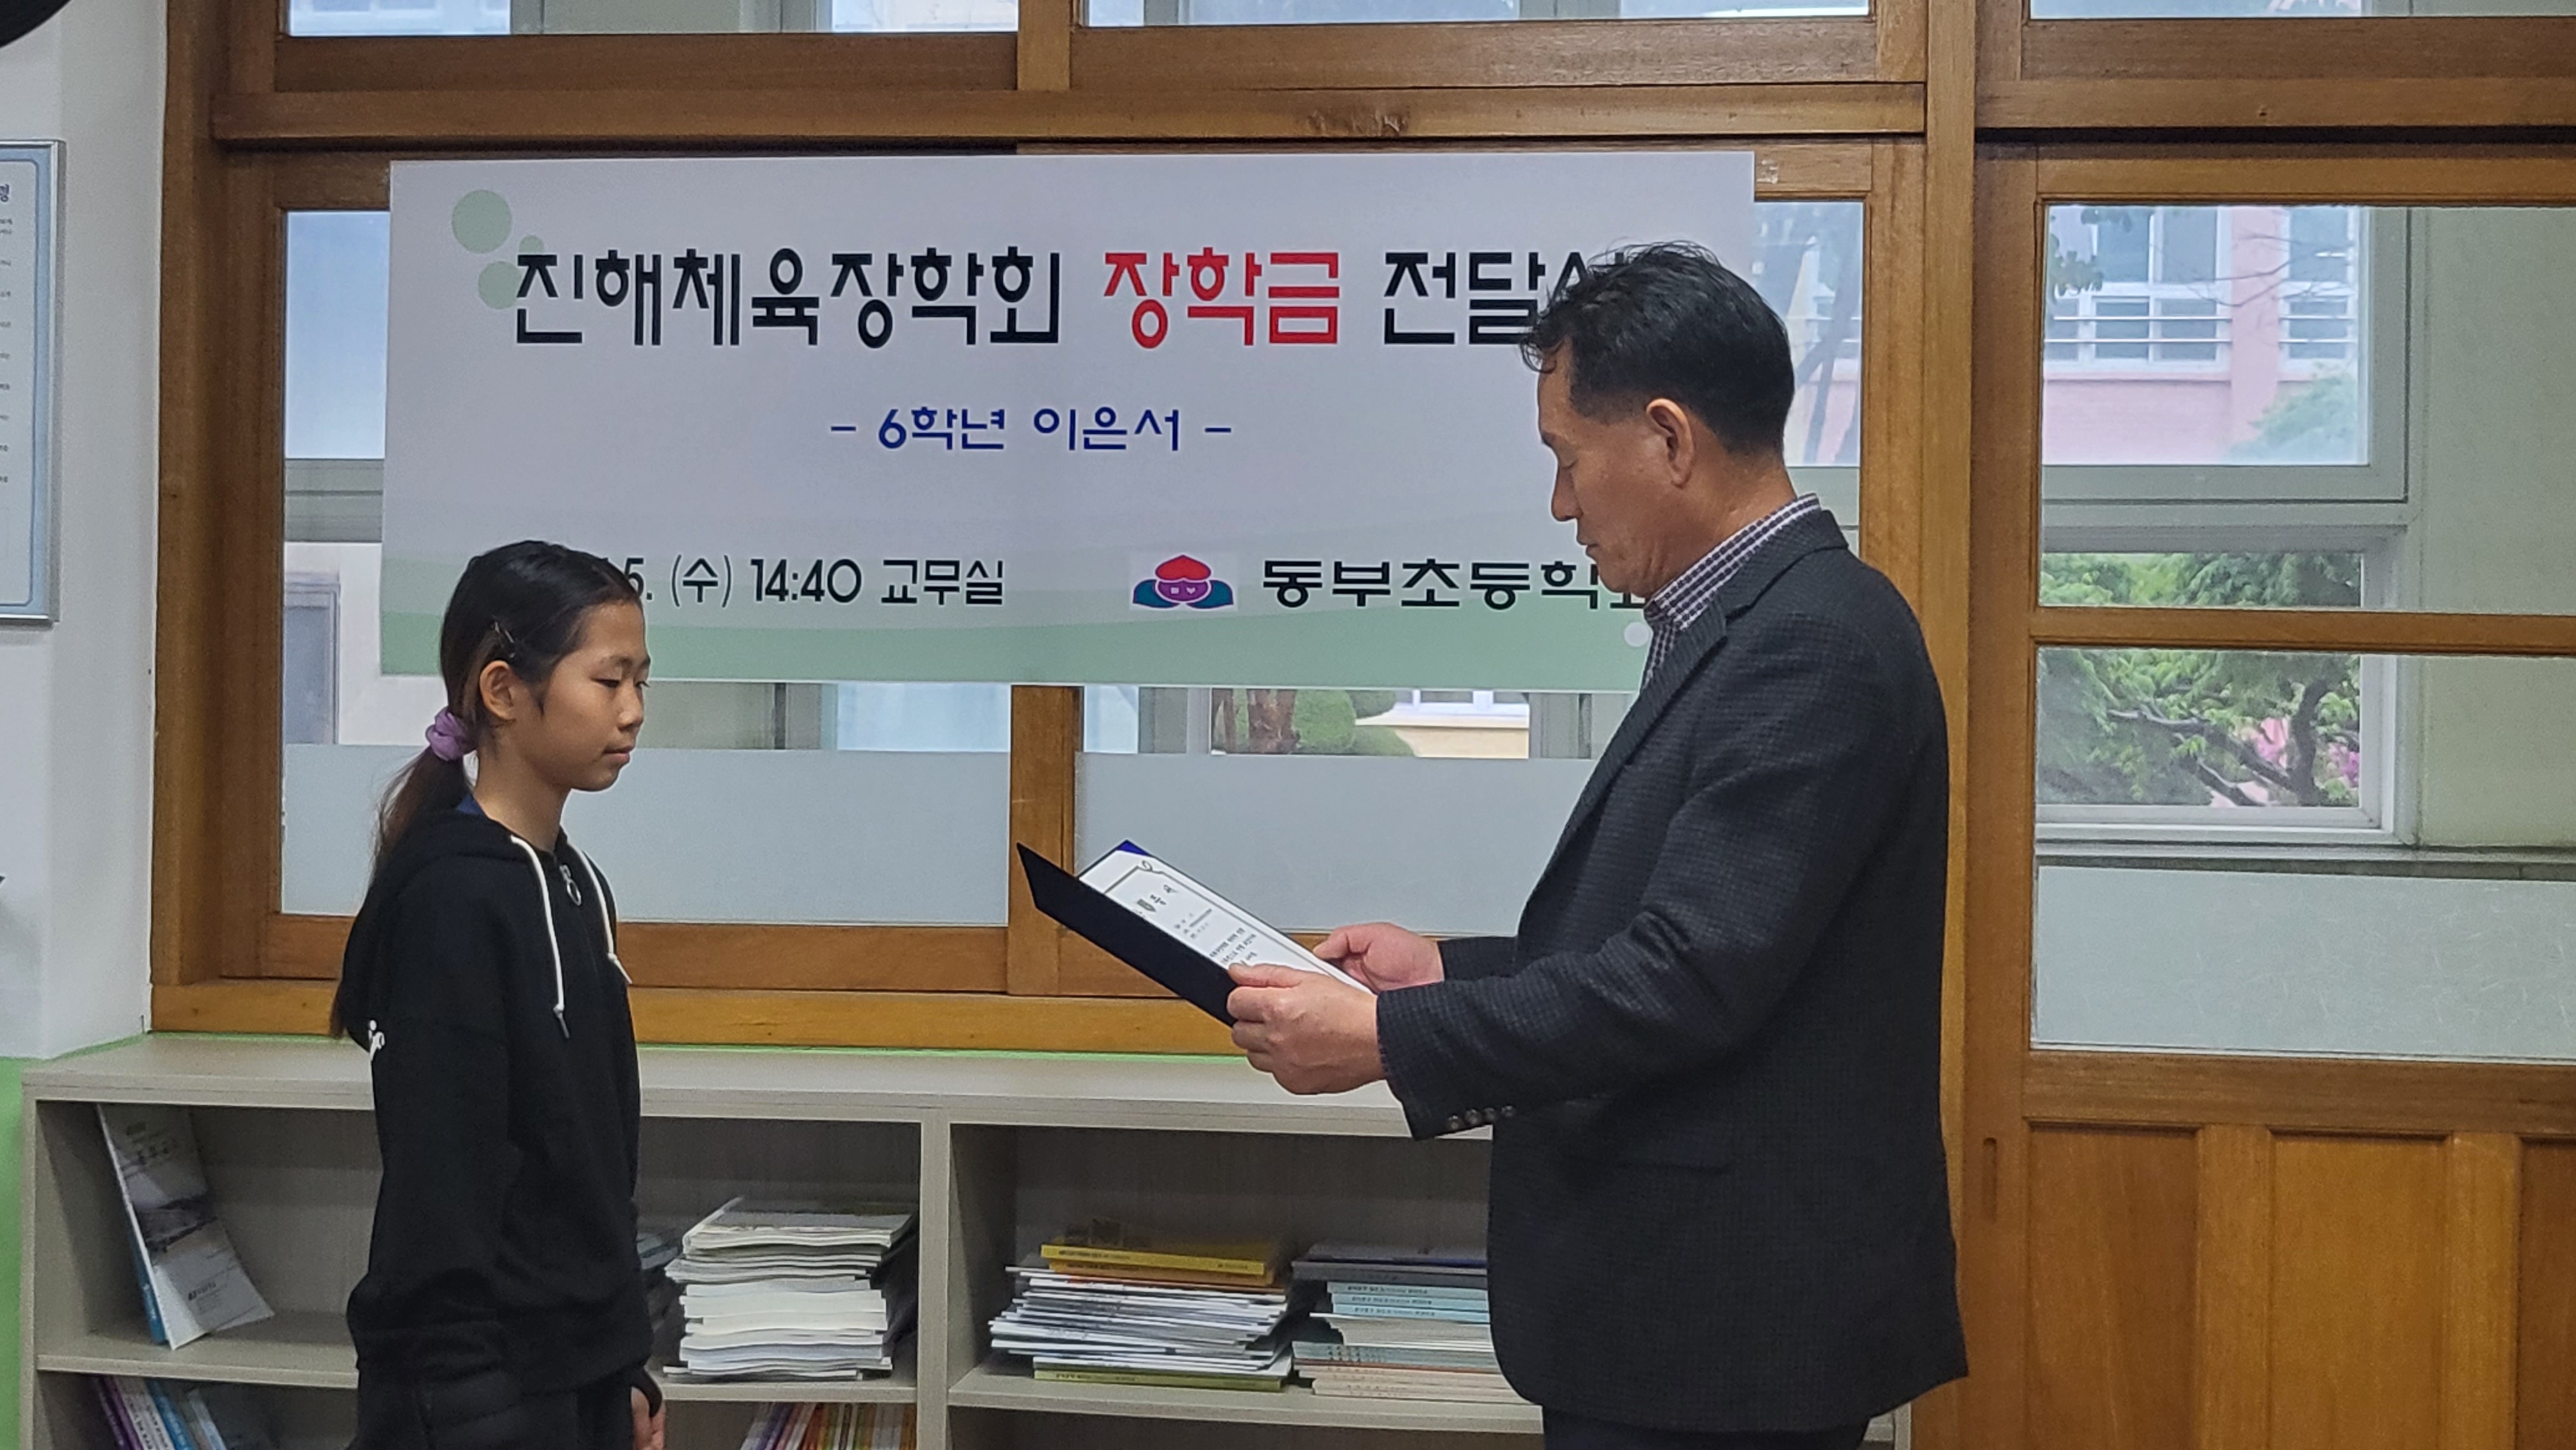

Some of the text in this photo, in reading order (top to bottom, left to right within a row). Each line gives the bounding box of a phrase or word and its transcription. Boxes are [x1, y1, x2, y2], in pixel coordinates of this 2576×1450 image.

[516, 246, 1061, 349] 진해체육장학회
[1104, 246, 1340, 349] 장학금
[878, 406, 1005, 451] 6학년
[1033, 406, 1180, 451] 이은서
[672, 554, 733, 608] (수)
[750, 558, 862, 603] 14:40
[880, 559, 1004, 607] 교무실
